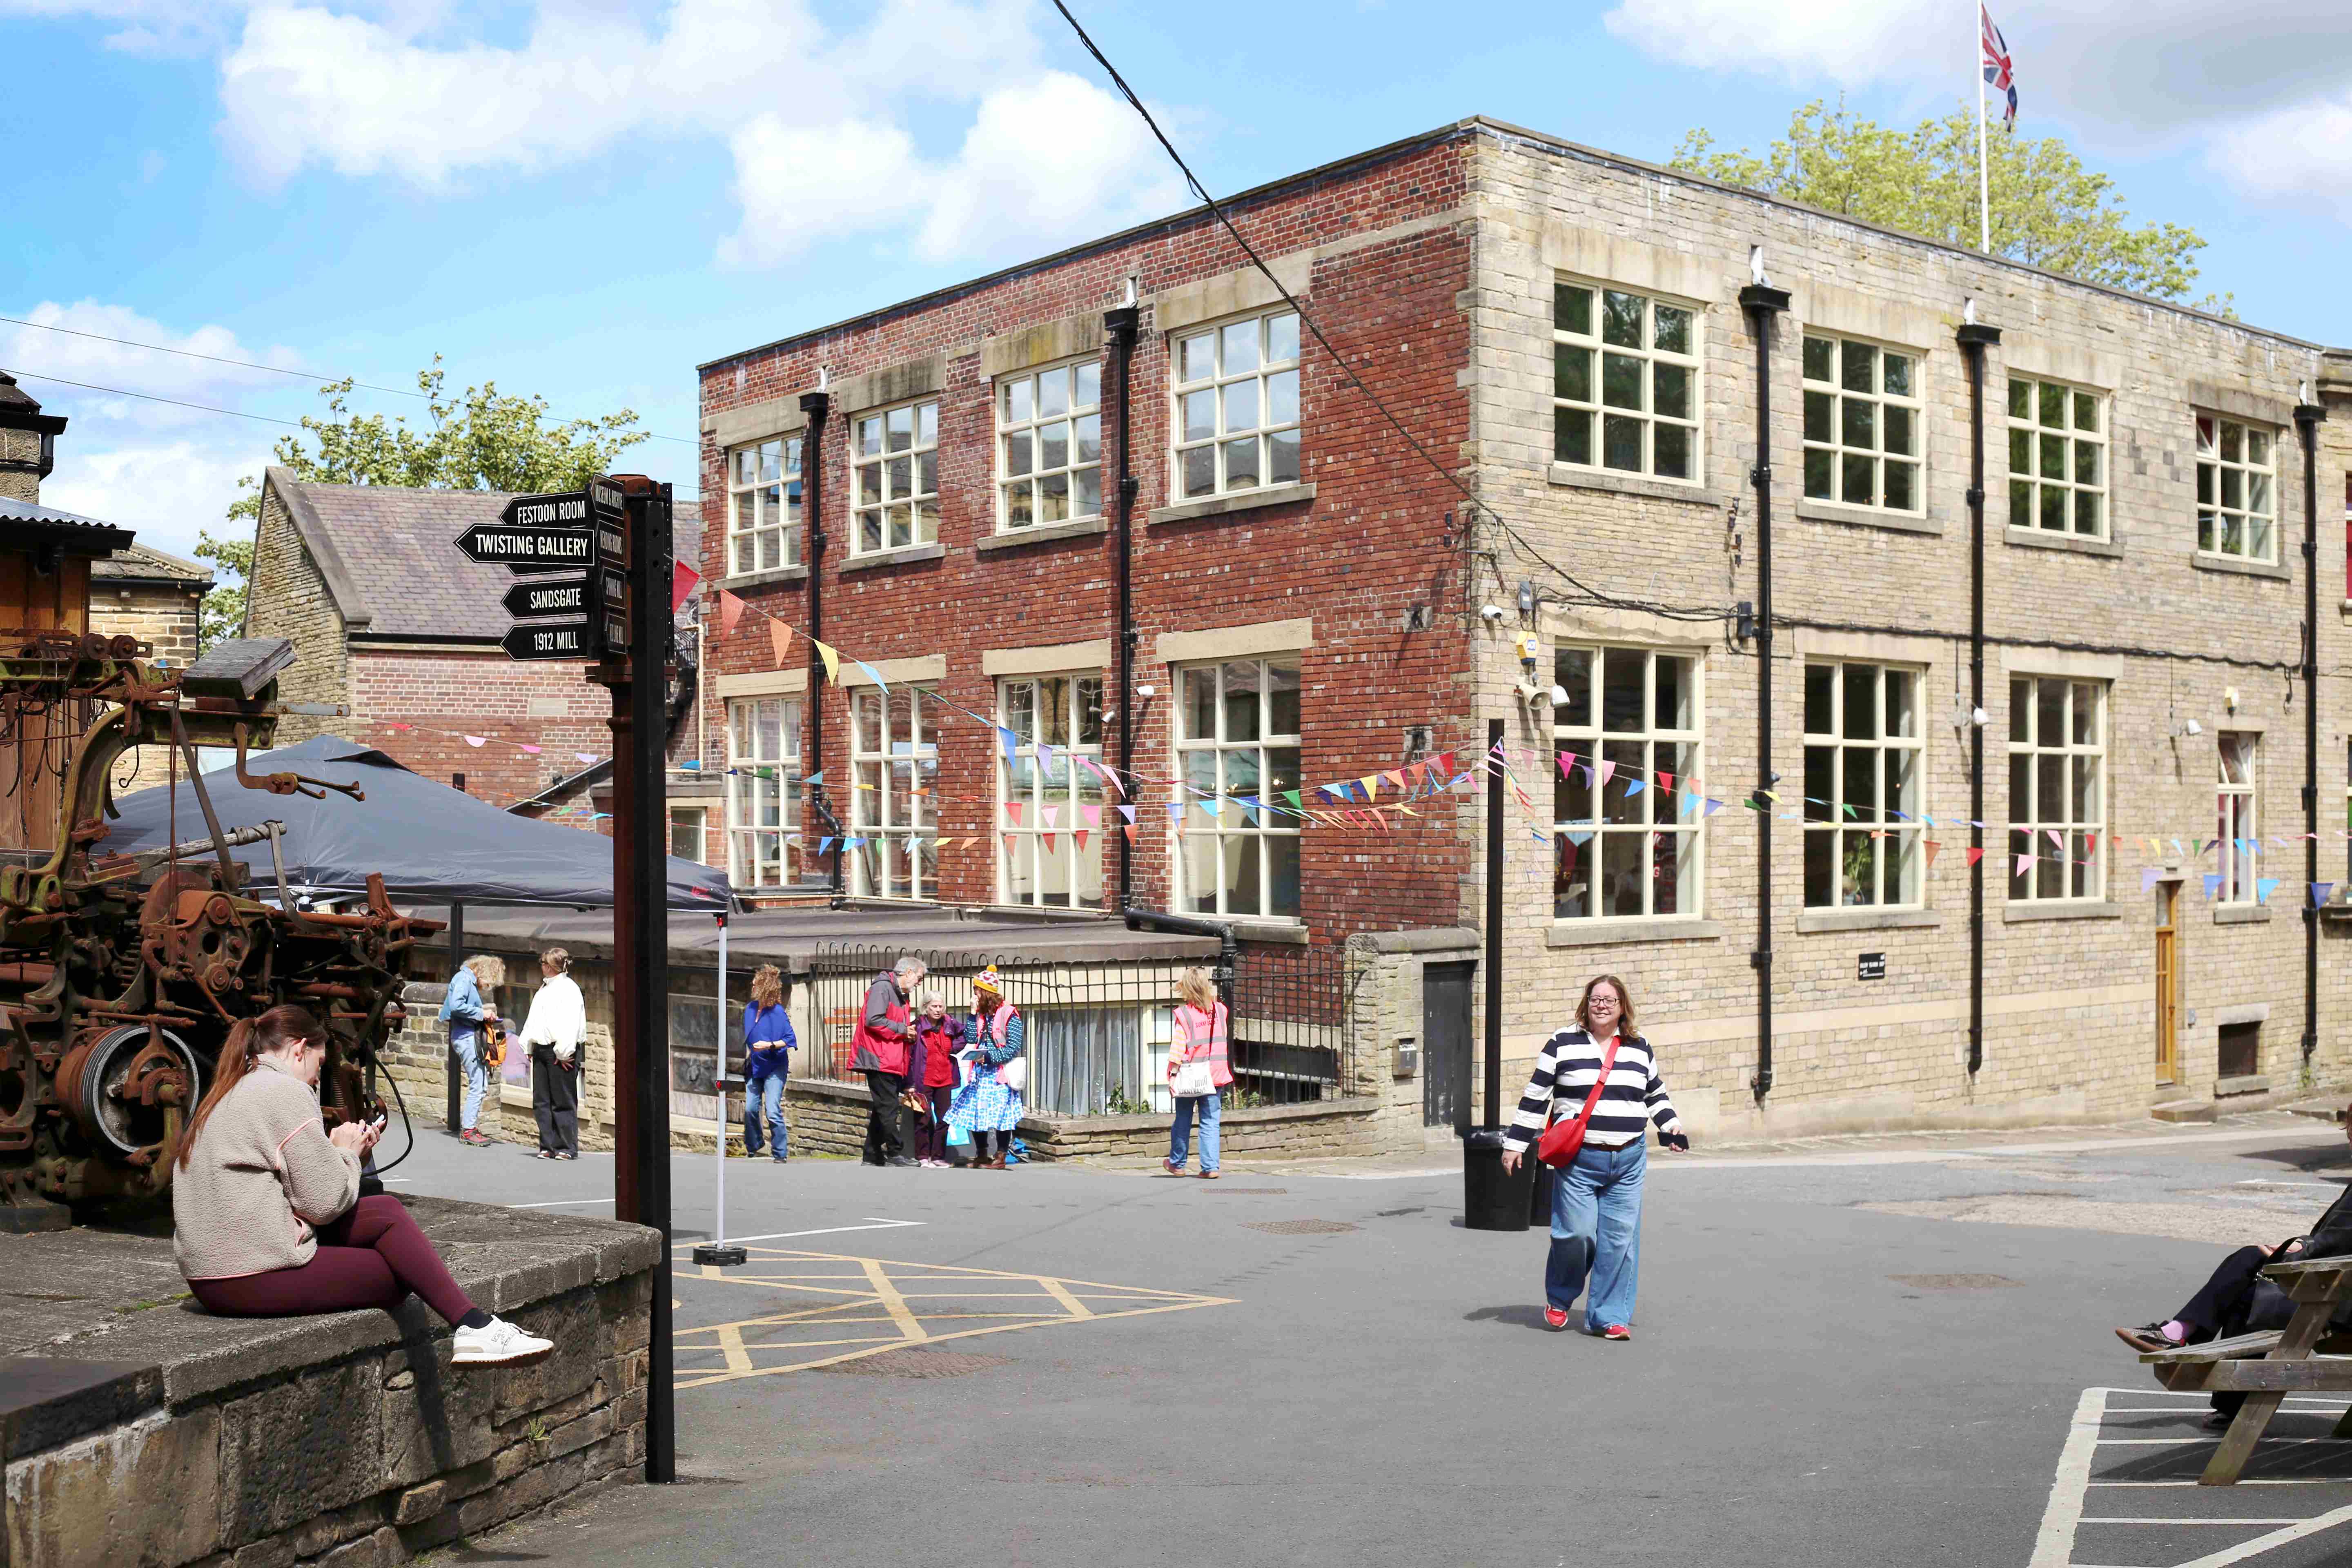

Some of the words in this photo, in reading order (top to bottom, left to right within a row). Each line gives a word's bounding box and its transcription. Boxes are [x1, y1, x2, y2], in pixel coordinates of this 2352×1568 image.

[595, 484, 608, 505] MUSEUM
[609, 488, 611, 506] &
[517, 503, 556, 524] FESTOON
[559, 501, 585, 518] ROOM
[476, 534, 533, 555] TWISTING
[538, 536, 588, 557] GALLERY
[530, 588, 581, 609] SANDSGATE
[534, 633, 554, 650] 1912
[557, 631, 579, 649] MILL
